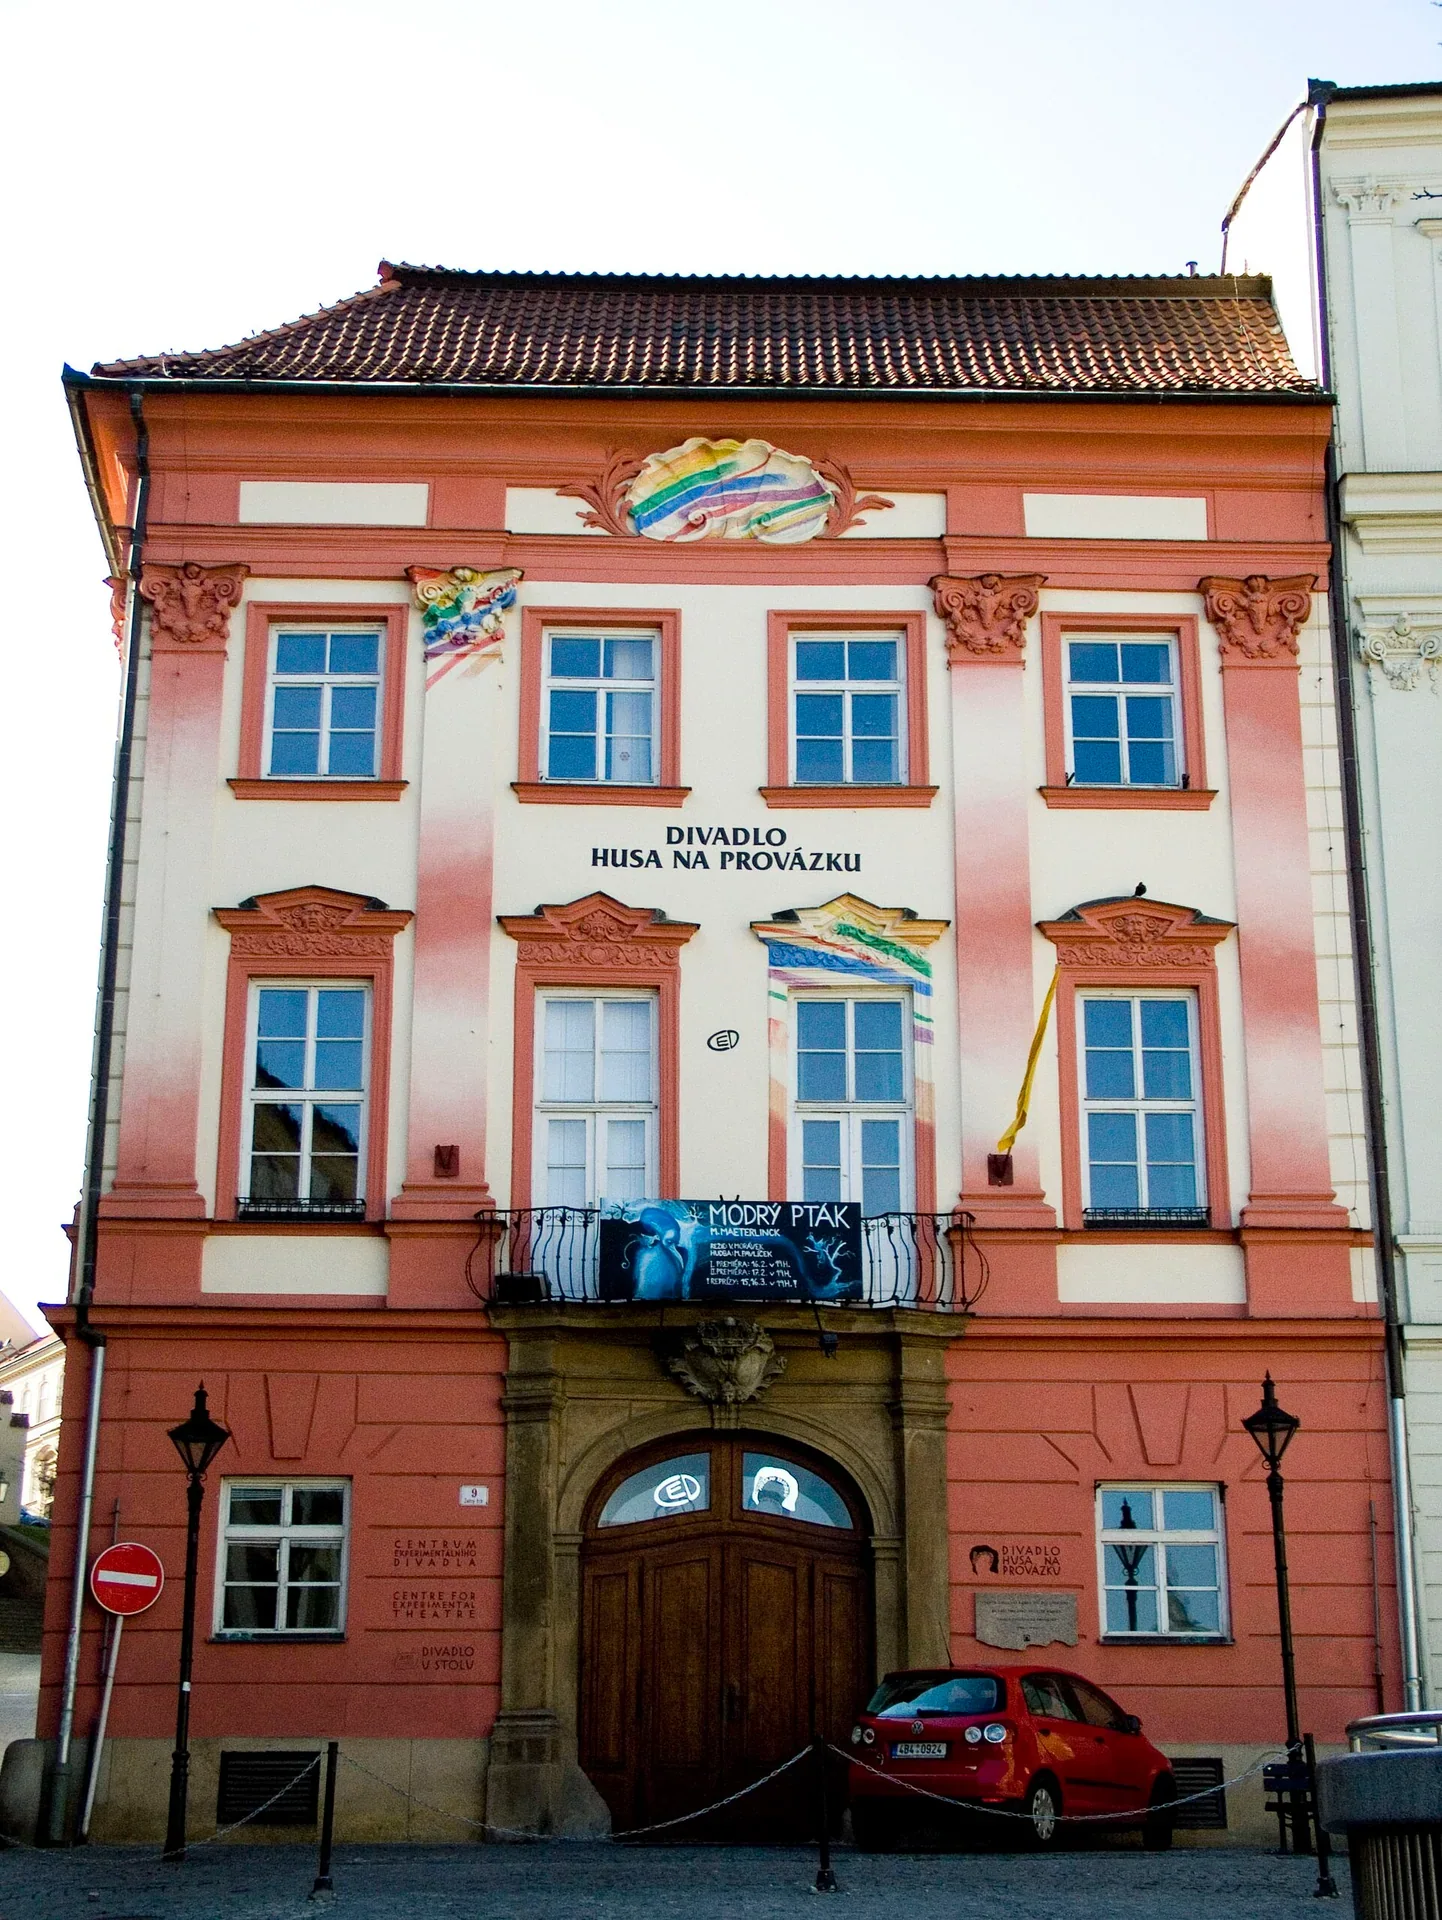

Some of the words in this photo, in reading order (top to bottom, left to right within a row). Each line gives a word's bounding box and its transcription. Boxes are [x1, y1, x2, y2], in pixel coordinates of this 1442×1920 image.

[666, 826, 787, 847] DIVADLO
[591, 848, 663, 869] HUSA
[673, 850, 710, 870] NA
[720, 847, 861, 872] PROVÁZKU
[709, 1202, 782, 1226] MODRÝ
[791, 1203, 850, 1229] PTÁK
[471, 1487, 478, 1498] 9
[394, 1540, 477, 1549] CENTRUM
[1002, 1546, 1061, 1556] DIVADLO
[393, 1558, 476, 1567] DIVADLA
[1002, 1555, 1033, 1565] HUSA
[1044, 1556, 1061, 1566] NA
[393, 1591, 444, 1600] CENTRE
[451, 1591, 475, 1600] FOR
[392, 1601, 475, 1609] EXPERIMENTAL
[392, 1609, 475, 1618] THEATRE
[422, 1646, 475, 1657] DIVADLO
[421, 1660, 430, 1670] U
[434, 1660, 474, 1670] STOLU
